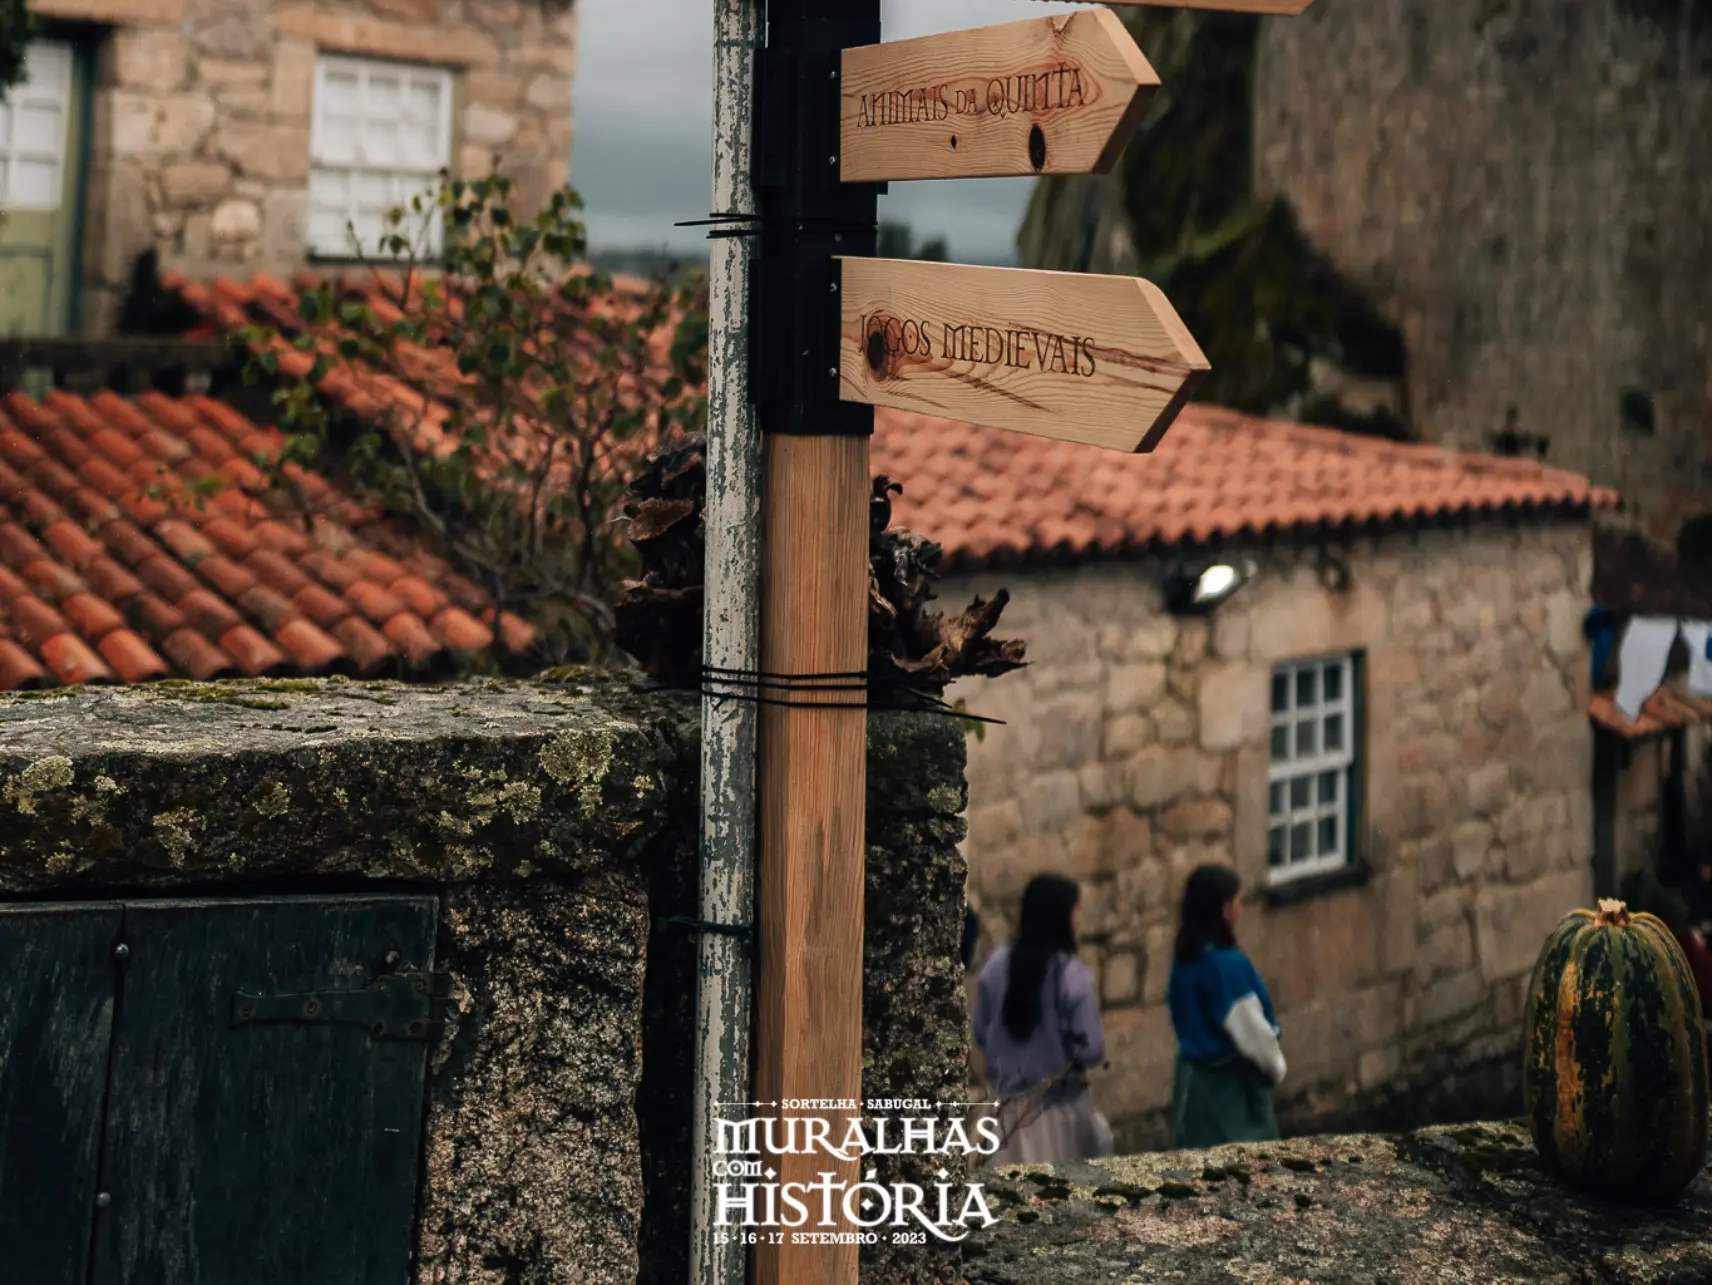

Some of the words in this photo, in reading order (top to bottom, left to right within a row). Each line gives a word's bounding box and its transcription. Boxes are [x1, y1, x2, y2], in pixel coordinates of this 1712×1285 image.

[856, 83, 950, 129] ANIMAIS
[955, 89, 979, 114] DA
[985, 61, 1087, 119] QUINTA
[857, 314, 932, 358] JOGOS
[940, 322, 1098, 378] MEDIEVAIS
